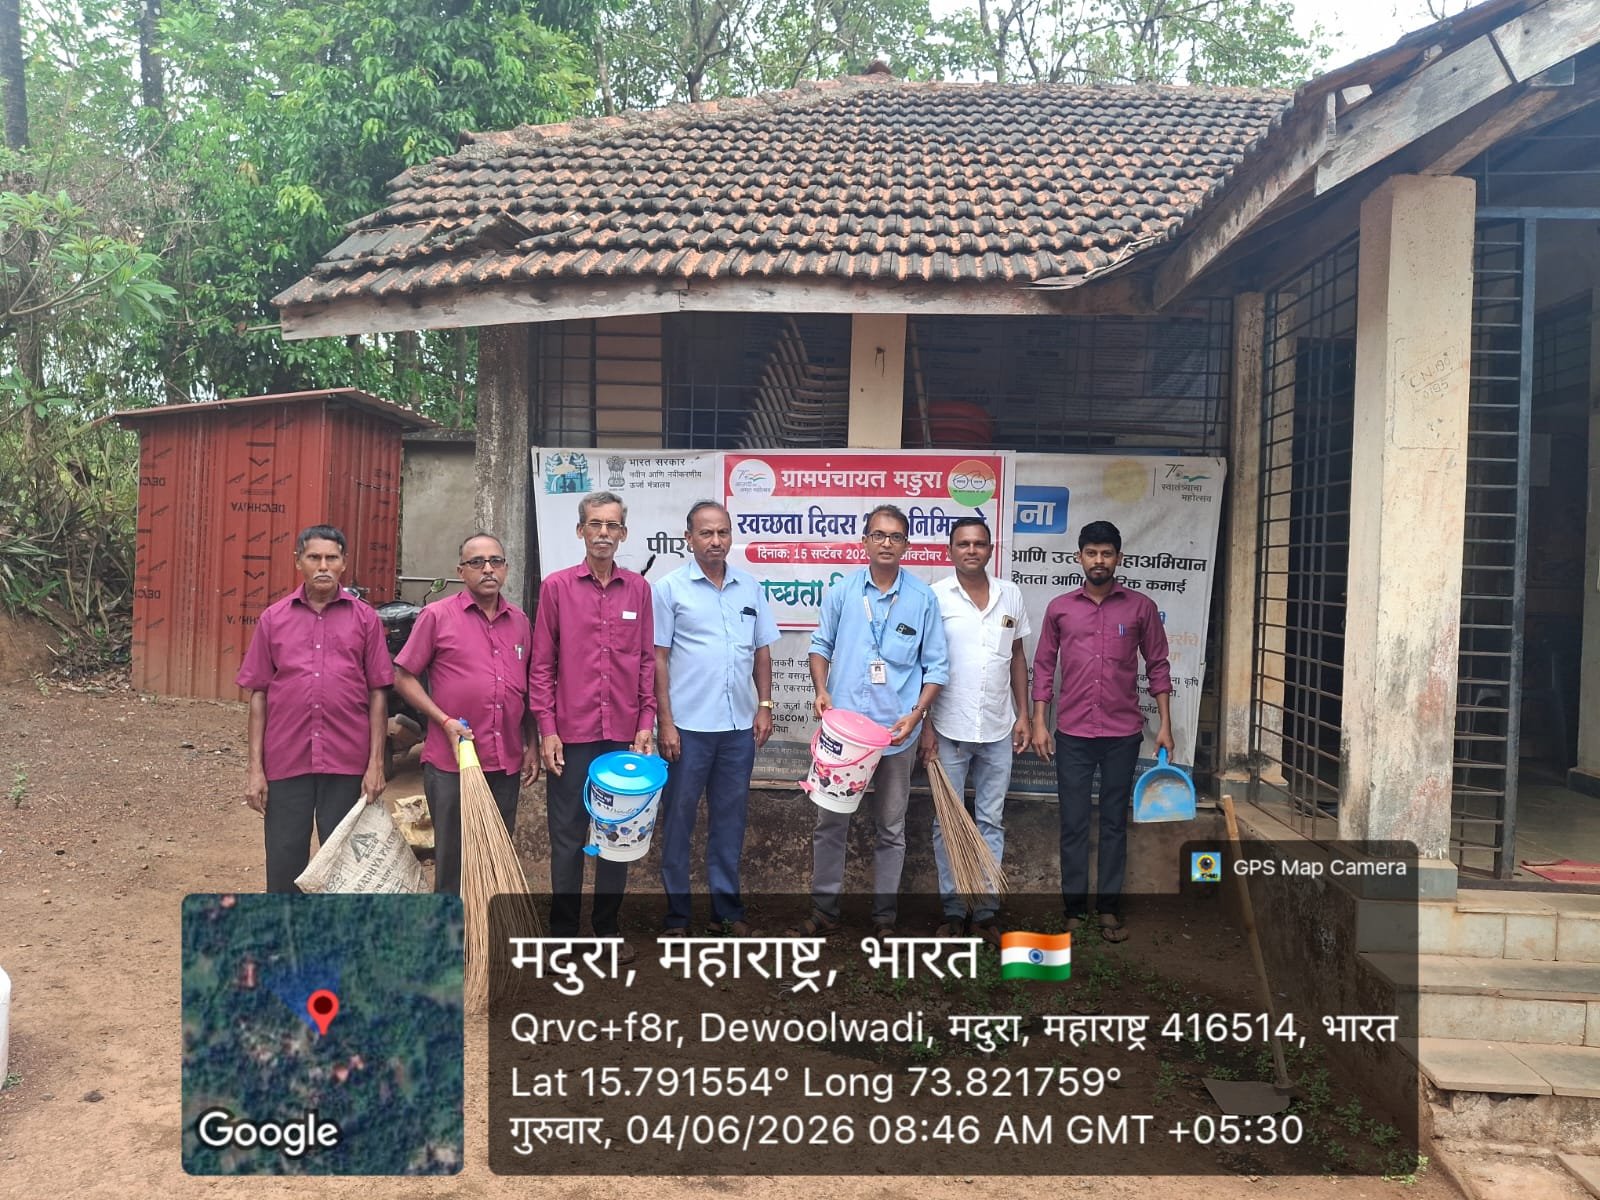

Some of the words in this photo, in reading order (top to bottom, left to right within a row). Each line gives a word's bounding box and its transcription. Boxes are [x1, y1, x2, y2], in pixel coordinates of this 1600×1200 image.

[629, 458, 651, 467] भारत
[655, 458, 686, 467] सरकार
[781, 462, 887, 489] ग्रामपंचायत
[893, 471, 943, 497] मडुरा
[737, 513, 803, 535] स्वच्छता
[808, 505, 857, 537] दिवस
[794, 548, 807, 559] 15
[1116, 553, 1207, 571] हाअभियान
[759, 579, 824, 607] च्छता
[1051, 572, 1084, 586] आणि
[1145, 578, 1187, 594] कमाई
